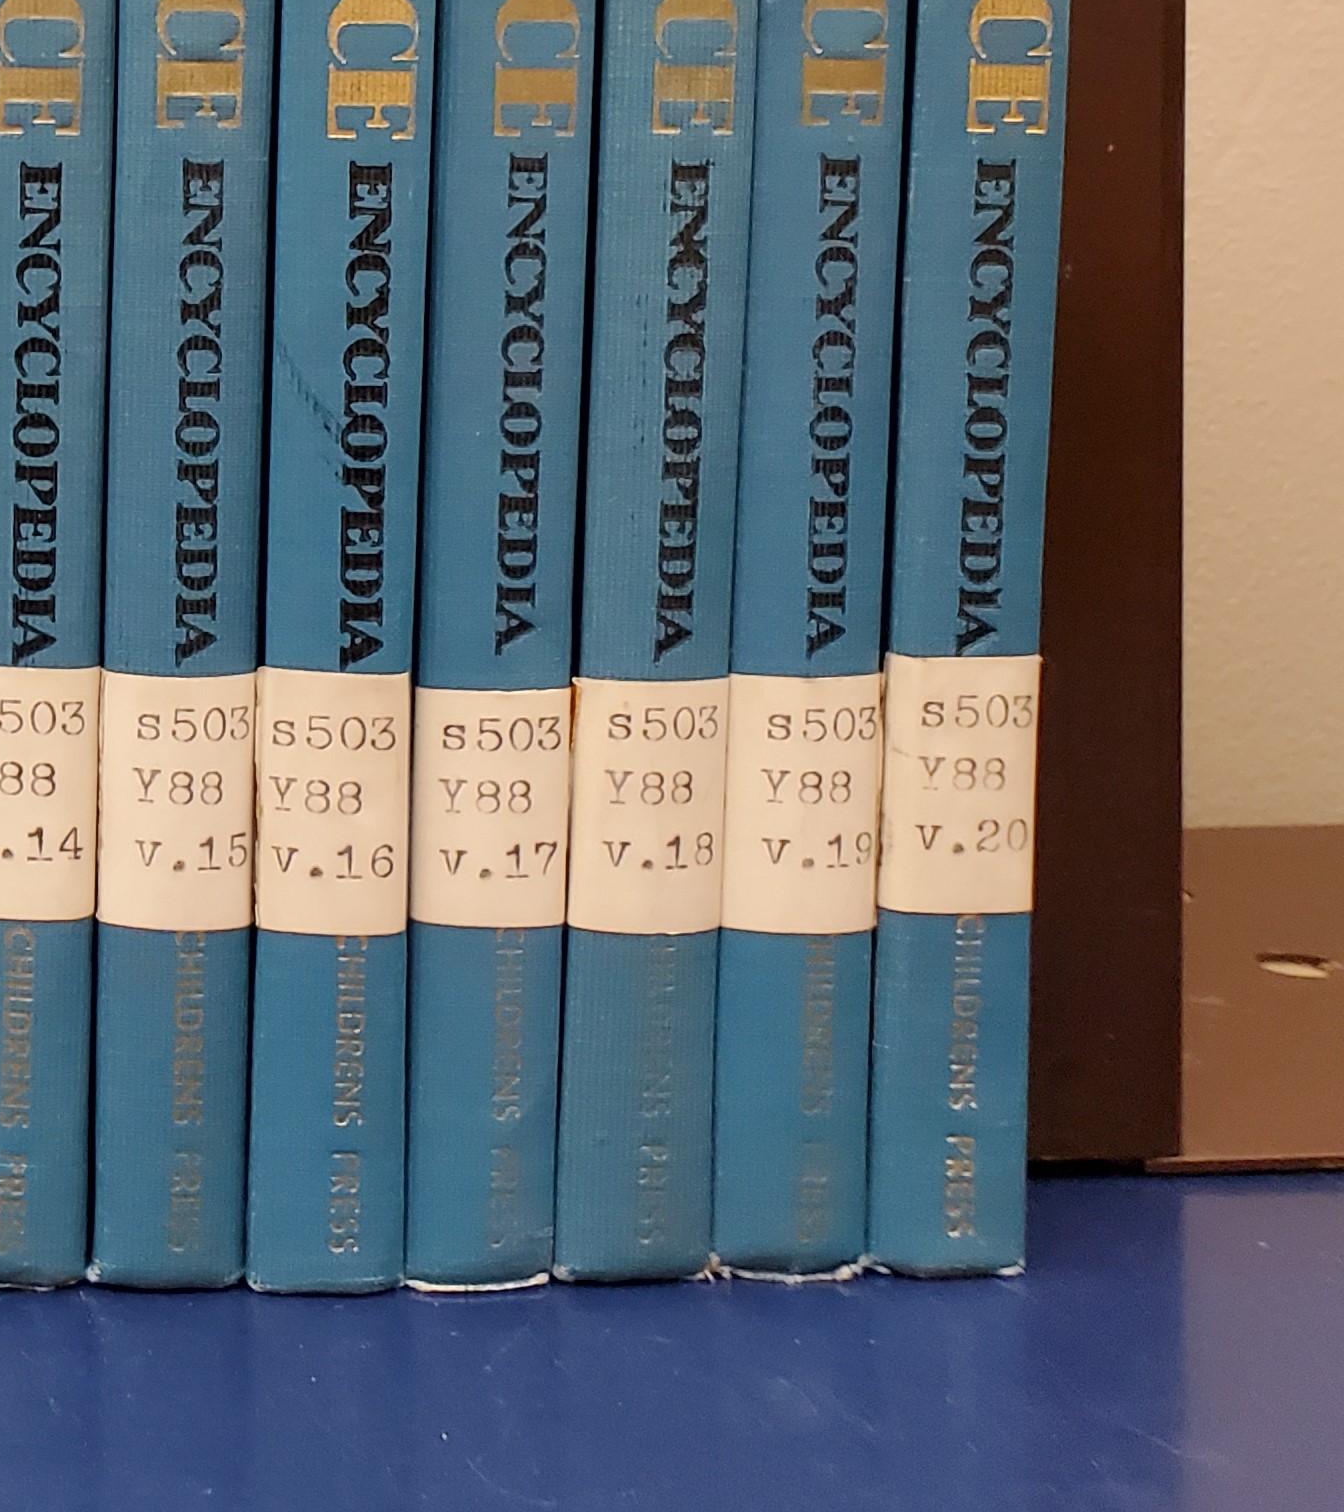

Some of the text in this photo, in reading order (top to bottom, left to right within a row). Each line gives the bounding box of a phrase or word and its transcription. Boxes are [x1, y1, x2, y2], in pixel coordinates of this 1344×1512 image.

[174, 157, 225, 668] ENCYCLOPEDIA
[494, 152, 548, 656] ENCYCLOPEDIA
[953, 157, 1017, 657] ENCYCLOPEDIA
[132, 767, 224, 806] Y88
[605, 769, 694, 806] Y88
[761, 768, 852, 805] Y88
[918, 755, 1006, 791] Y88
[269, 775, 363, 815] Y88
[438, 778, 532, 814] Y88
